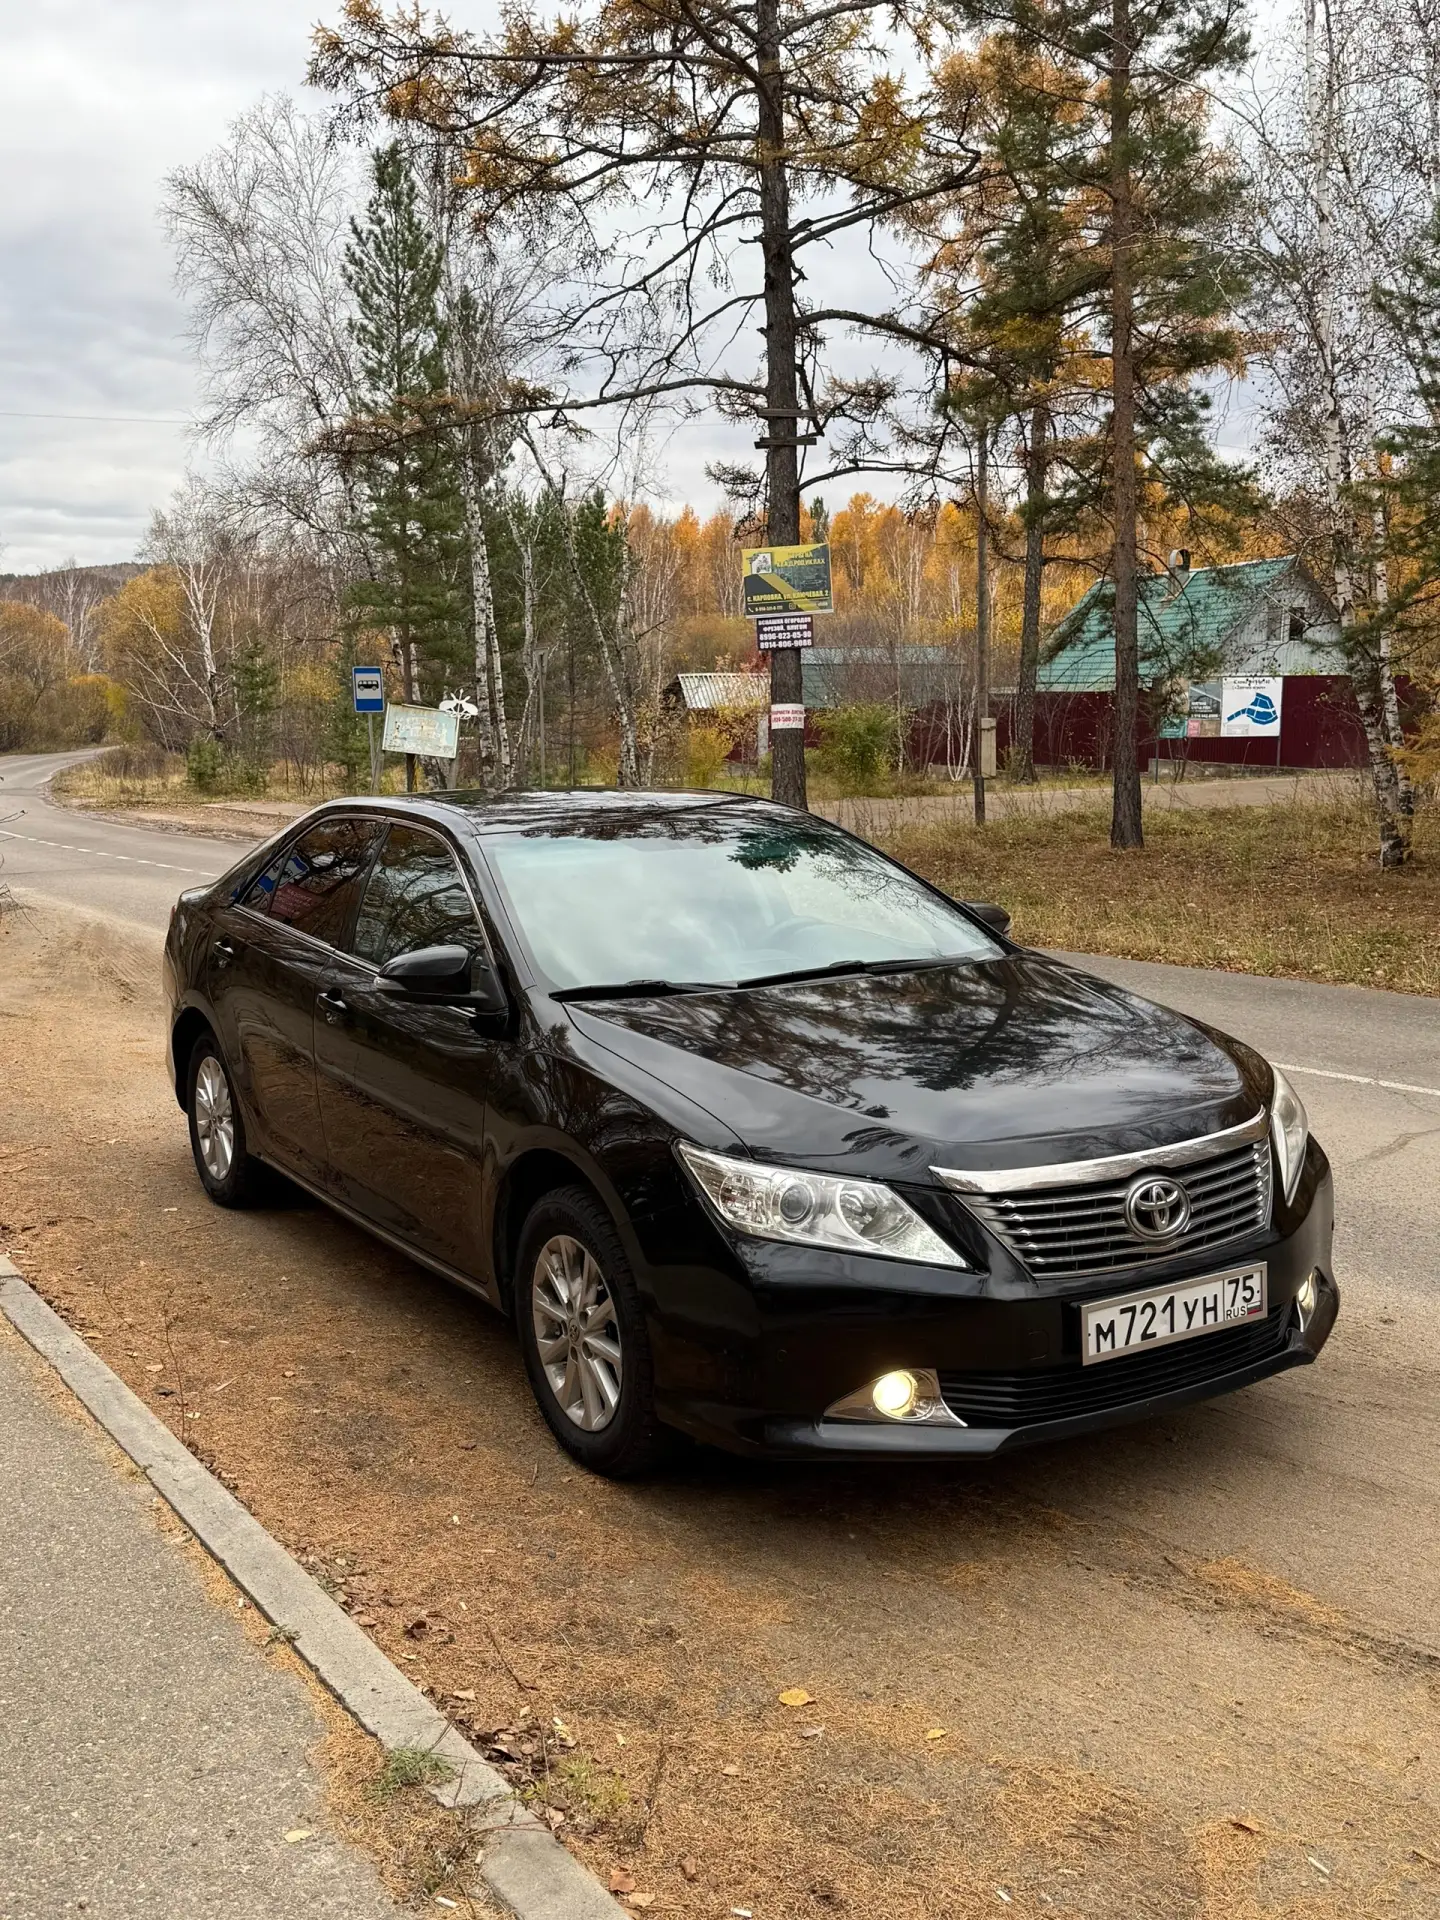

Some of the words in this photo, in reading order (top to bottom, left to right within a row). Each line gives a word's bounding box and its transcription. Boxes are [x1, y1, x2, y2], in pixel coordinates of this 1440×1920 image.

[784, 616, 812, 624] ОГОРОДОВ
[1095, 1293, 1218, 1353] М721УН
[1227, 1273, 1255, 1308] 75
[1225, 1303, 1247, 1320] RUS
